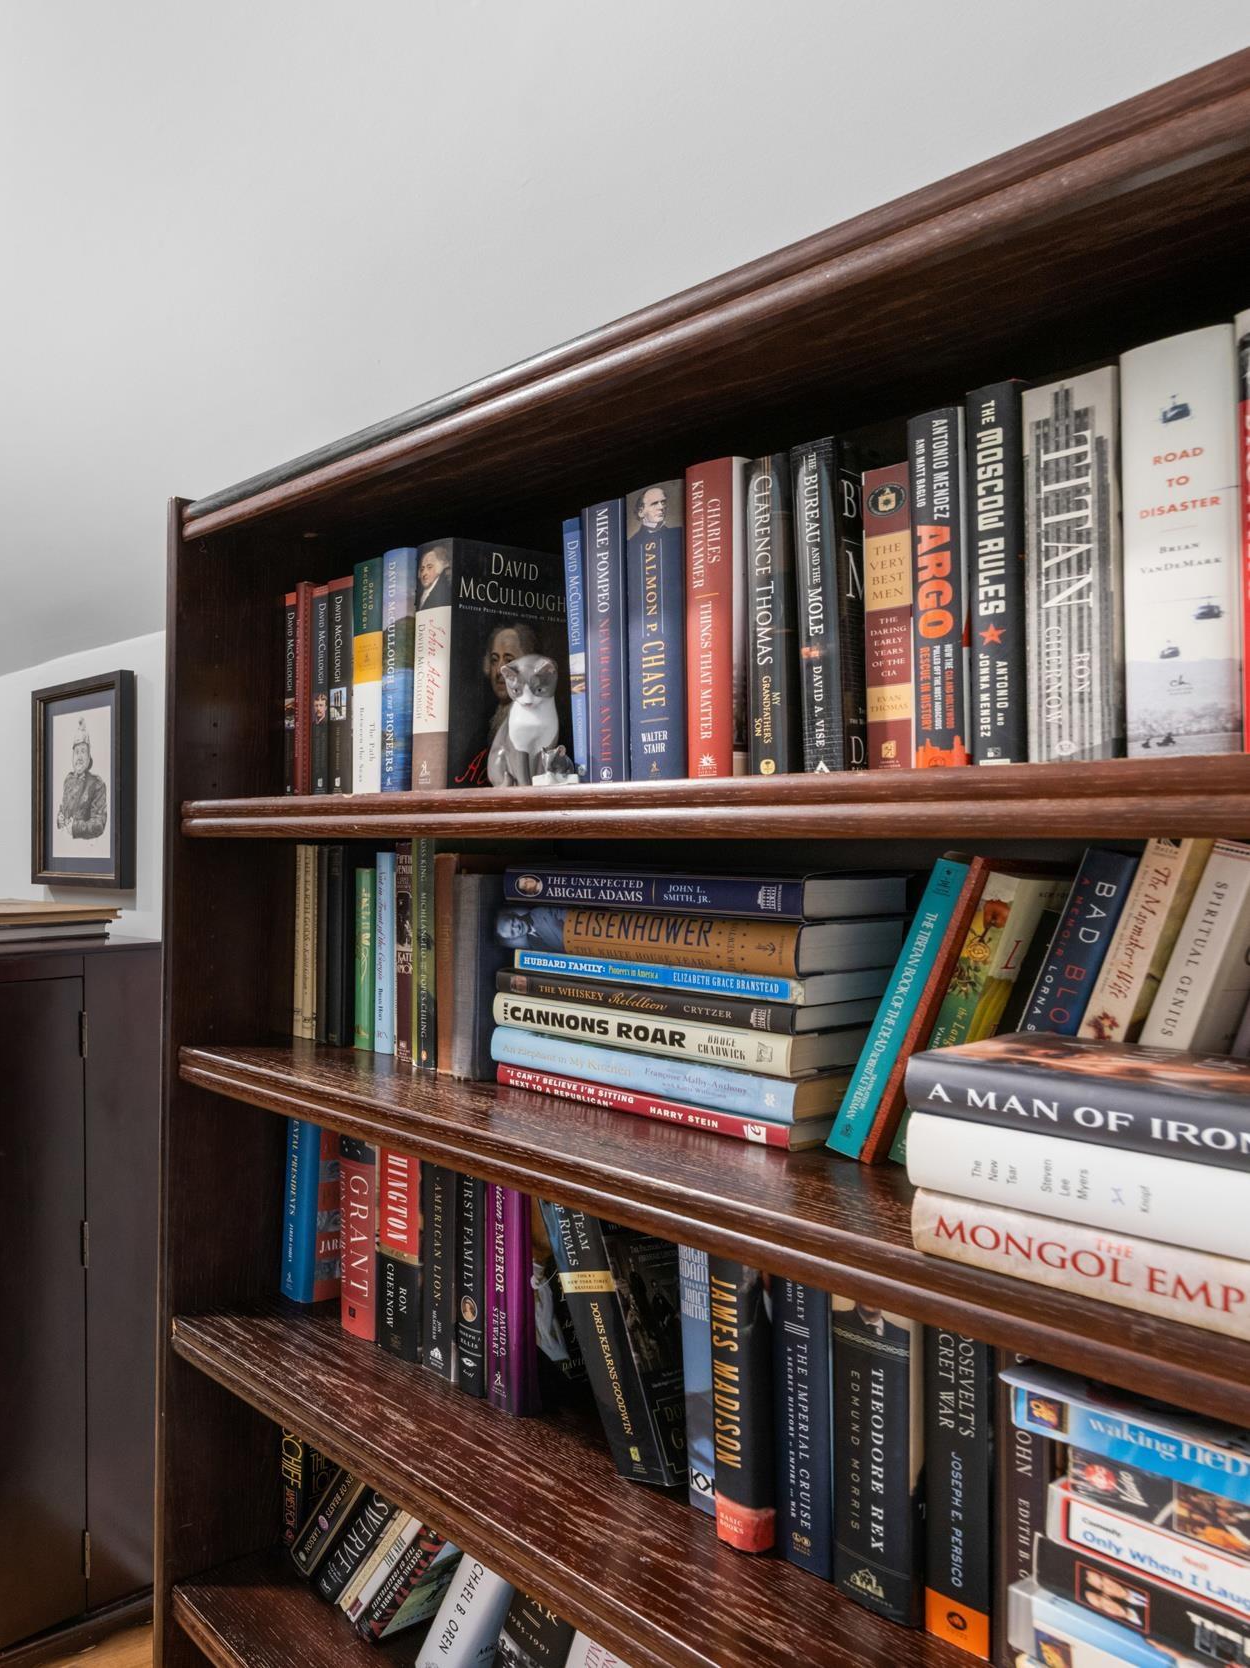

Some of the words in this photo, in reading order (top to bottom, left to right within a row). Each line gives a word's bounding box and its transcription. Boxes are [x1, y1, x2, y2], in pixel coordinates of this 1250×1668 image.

[982, 400, 995, 425] THE
[808, 452, 816, 471] THE
[915, 438, 925, 455] AND
[932, 419, 949, 469] ANTONIO
[1152, 447, 1204, 465] ROAD
[915, 456, 926, 477] MATT
[977, 427, 1004, 531] MOSCOW
[1166, 475, 1190, 488] TO
[803, 473, 820, 543] BUREAU
[916, 478, 927, 508] BAGLIO
[933, 471, 949, 520] MENDEZ
[1140, 495, 1221, 520] DISASTER
[596, 508, 608, 548] MIKE
[691, 480, 705, 589] KRAUTHAMMER
[706, 498, 721, 564] CHARLES
[753, 475, 773, 576] CLARENCE
[1040, 429, 1093, 609] TITAN
[491, 552, 539, 581] DAVID
[567, 540, 579, 572] DAVID
[869, 556, 905, 571] VERY
[873, 542, 901, 556] THE
[597, 551, 609, 613] POMPEO
[645, 542, 658, 615] SALMON
[871, 571, 905, 586] BEST
[872, 587, 903, 601] MEN
[917, 525, 954, 638] ARGO
[978, 537, 1005, 616] RULES
[318, 603, 327, 628] DAVID
[335, 595, 343, 622] DAVID
[700, 601, 712, 649] THINGS
[756, 580, 774, 666] THOMAS
[808, 586, 824, 637] MOLE
[879, 616, 898, 624] THE
[599, 618, 611, 665] NEVER
[870, 626, 907, 636] DARING
[874, 637, 902, 647] EARLY
[700, 651, 712, 685] THAT
[874, 647, 904, 657] YEARS
[886, 658, 906, 666] THE
[642, 640, 666, 709] CHASE
[812, 665, 823, 702] DAVID
[881, 669, 897, 677] CIA
[979, 653, 990, 690] JONNA
[996, 661, 1009, 709] ANTONIO
[1045, 626, 1062, 725] CHERNOW
[1072, 652, 1090, 694] RON
[700, 688, 712, 740] MATTER
[762, 675, 772, 744] GRANDFATHER'S
[772, 691, 782, 706] MY
[980, 693, 991, 737] MENDEZ
[601, 728, 612, 761] INCH
[641, 730, 668, 742] WALTER
[754, 718, 762, 737] SON
[815, 720, 826, 747] VISE
[643, 743, 666, 755] STAHR
[546, 876, 567, 886] THE
[570, 878, 644, 889] UNEXPECTED
[546, 887, 596, 899] ABIGAIL
[597, 890, 643, 902] ADAMS
[667, 884, 693, 893] JOHN
[1148, 867, 1171, 892] The
[663, 894, 696, 903] SMITH,
[697, 895, 711, 904] JR.
[1078, 881, 1117, 944] BAD
[573, 910, 713, 948] EISENHOWER
[1185, 881, 1229, 968] SPIRITUAL
[908, 930, 932, 968] TIBETAN
[523, 956, 566, 969] HUBBARD
[568, 961, 606, 973] FAMILY:
[673, 971, 710, 986] ELIZABETH
[711, 977, 734, 989] GRACE
[736, 980, 779, 994] BRANSTEAD
[895, 967, 917, 996] BOOK
[1033, 965, 1058, 1015] LORNA
[538, 985, 556, 994] THE
[557, 987, 604, 1000] WHISKEY
[608, 991, 667, 1011] Rebellion
[683, 1004, 732, 1019] CRYTZER
[1161, 976, 1193, 1037] GENIUS
[510, 1006, 609, 1036] CANNONS
[617, 1022, 686, 1049] ROAR
[707, 1034, 736, 1047] BRUCE
[873, 1027, 894, 1053] DEAD
[697, 1043, 746, 1061] CHADWICK
[509, 1079, 529, 1089] NEXT
[553, 1089, 613, 1107] REPUBLICAN"
[516, 1071, 541, 1083] CAN'T
[542, 1077, 578, 1091] BELIEVE
[580, 1085, 595, 1095] I'M
[598, 1090, 634, 1104] SITTING
[650, 1106, 684, 1120] HARRY
[687, 1114, 719, 1128] STEIN
[927, 1083, 952, 1103] A
[967, 1088, 1058, 1123] MAN
[1073, 1106, 1135, 1132] OF
[289, 1154, 299, 1216] PRESIDENTS
[972, 1160, 981, 1178] The
[989, 1159, 999, 1182] New
[1007, 1164, 1017, 1185] Tsar
[1041, 1158, 1052, 1193] Steven
[1060, 1178, 1070, 1196] Lee
[1077, 1168, 1089, 1200] Myers
[350, 1174, 369, 1298] GRANT
[434, 1183, 442, 1258] AMERICAN
[573, 1211, 590, 1250] TEAM
[463, 1226, 473, 1291] FAMILY
[495, 1223, 505, 1293] EMPEROR
[558, 1219, 579, 1267] RIVALS
[934, 1215, 1132, 1287] MONGOL
[1094, 1237, 1135, 1259] THE
[386, 1263, 395, 1328] CHERNOW
[398, 1287, 407, 1314] RON
[433, 1264, 442, 1300] LION
[711, 1276, 739, 1352] JAMES
[590, 1302, 606, 1337] DORIS
[600, 1335, 619, 1380] KEARNS
[613, 1380, 634, 1436] GOODWIN
[797, 1344, 807, 1376] THE
[713, 1359, 741, 1469] MADISON
[798, 1383, 809, 1460] IMPERIAL
[850, 1370, 860, 1446] EDMUND
[938, 1391, 955, 1429] WAR
[870, 1368, 884, 1494] THEODORE
[1088, 1417, 1178, 1461] waking
[850, 1460, 860, 1531] MORRIS
[950, 1451, 962, 1507] JOSEPH
[325, 1495, 342, 1519] BEASTS
[799, 1468, 811, 1530] CRUISE
[335, 1492, 389, 1574] SWERVE
[719, 1519, 744, 1535] BOOKS
[720, 1512, 742, 1526] BASIC
[871, 1504, 884, 1553] REX
[1017, 1498, 1030, 1547] EDITH
[304, 1528, 322, 1554] LARSON
[951, 1527, 963, 1588] PERSICO
[1082, 1531, 1123, 1557] Only
[1128, 1547, 1184, 1580] When
[439, 1619, 459, 1655] OREN
